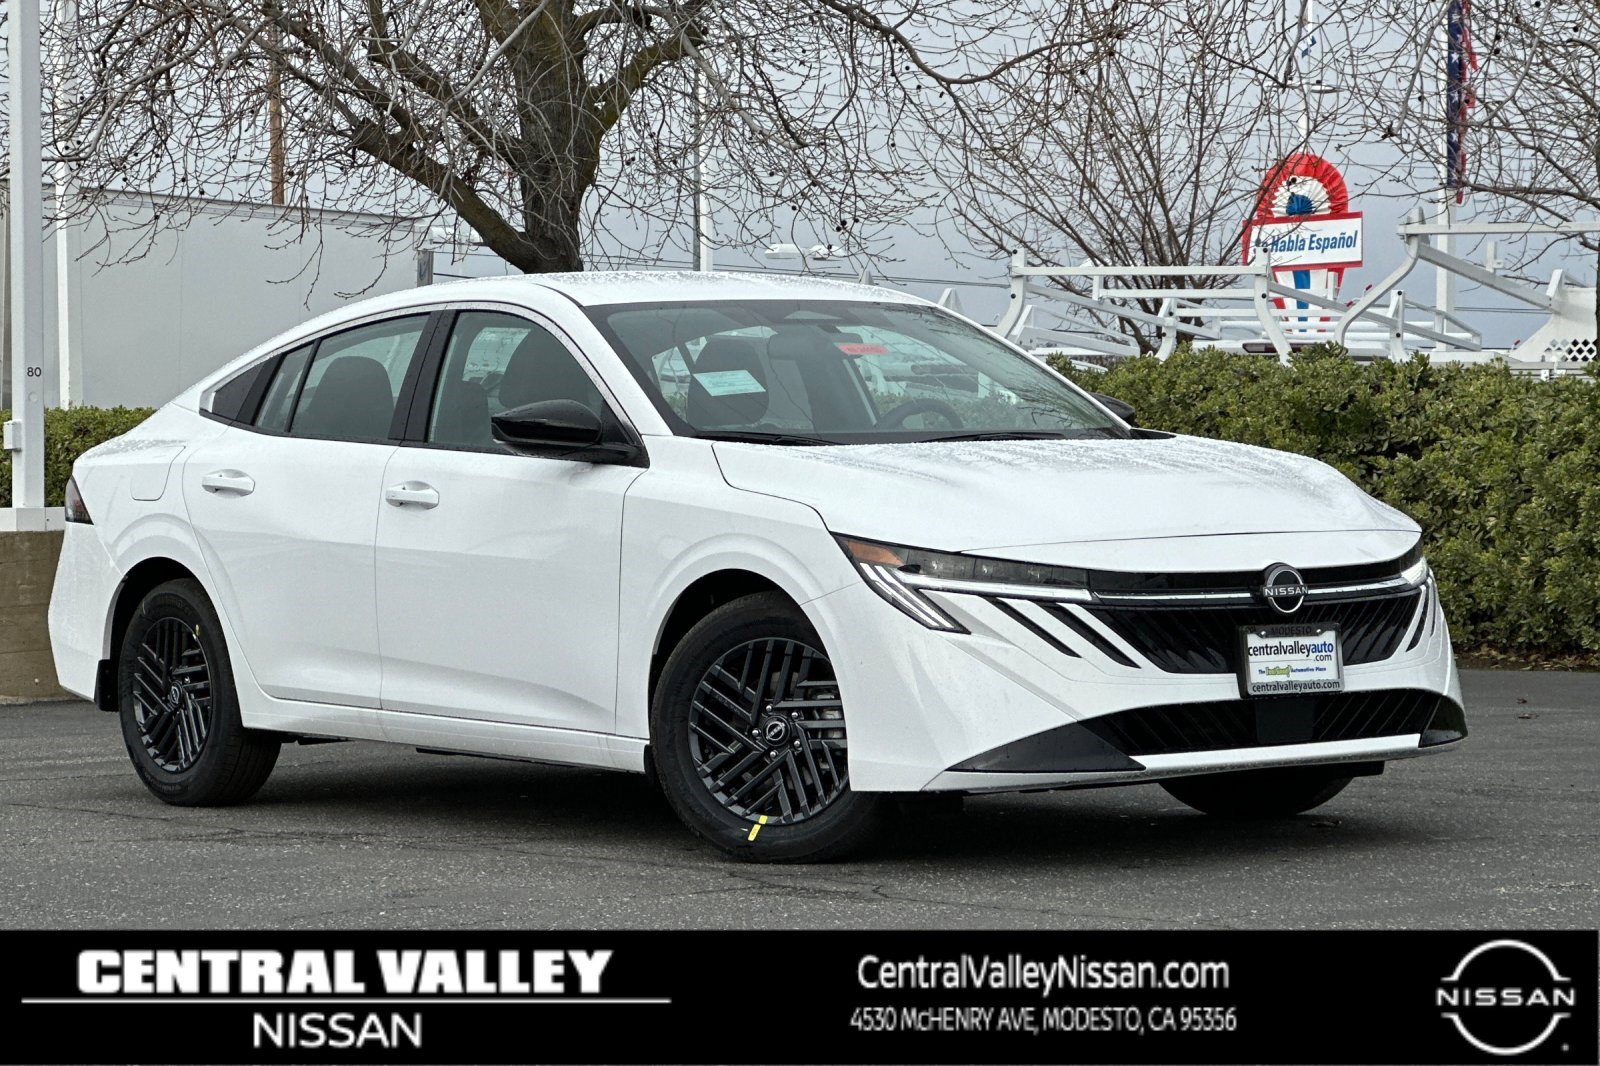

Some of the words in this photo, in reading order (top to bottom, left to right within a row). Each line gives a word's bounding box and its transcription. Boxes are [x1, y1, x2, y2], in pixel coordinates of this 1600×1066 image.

[1270, 234, 1306, 253] Habla
[1308, 230, 1358, 254] Español
[27, 366, 42, 377] 80
[1264, 586, 1308, 597] NISSAN
[1248, 641, 1334, 657] centralvalleyauto
[1313, 653, 1333, 662] .com
[1252, 680, 1340, 692] centralvalleyauto.com
